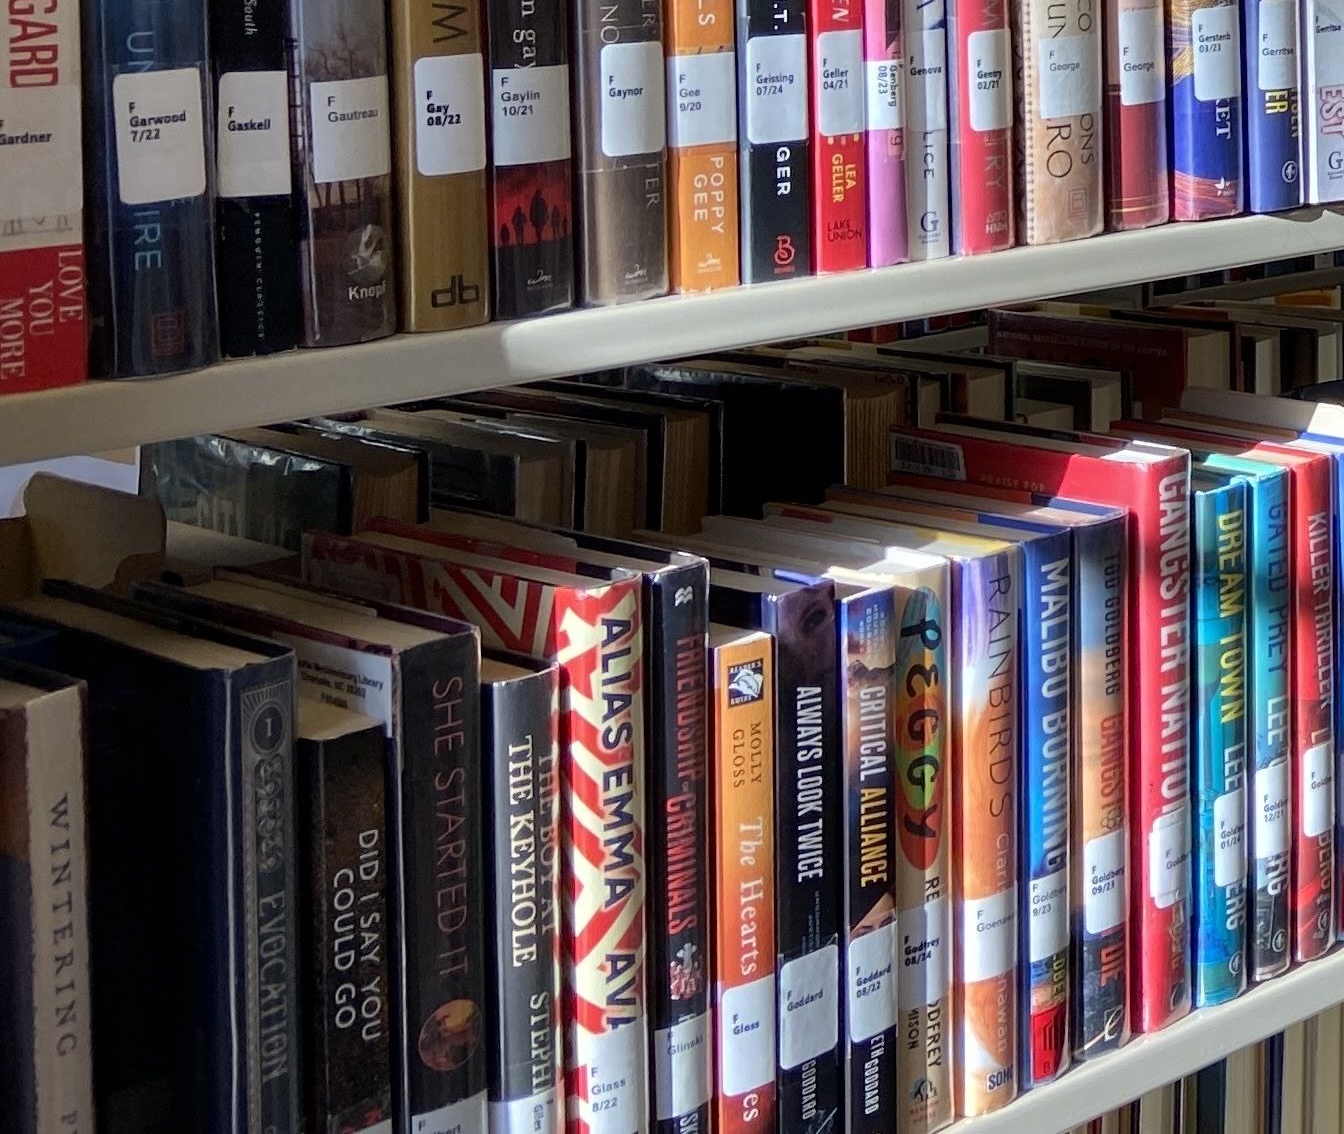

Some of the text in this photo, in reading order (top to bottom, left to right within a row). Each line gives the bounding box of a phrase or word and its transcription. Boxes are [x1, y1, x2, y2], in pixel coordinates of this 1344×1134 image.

[501, 89, 541, 103] Gaylin
[608, 86, 644, 98] Gaynor
[756, 72, 795, 85] Geissing
[756, 85, 783, 96] 07/24
[909, 65, 943, 77] Genova
[129, 111, 187, 127] Garwood
[228, 118, 271, 132] Gaskell
[426, 103, 450, 117] Gay
[501, 106, 534, 118] 10/21
[693, 174, 708, 222] GEE
[709, 156, 725, 235] POPPY
[831, 153, 845, 204] GELLER
[844, 163, 857, 190] LEA
[827, 229, 863, 243] UNION
[28, 281, 55, 337] YOU
[58, 250, 84, 323] LOVE
[348, 283, 387, 301] Knopf
[2, 298, 26, 378] MORE
[1158, 472, 1190, 674] GANGSTER
[1308, 511, 1331, 597] KILLER
[1104, 596, 1121, 697] GOLDBERG
[1217, 511, 1245, 723] DREAM TOWN
[859, 684, 887, 781] CRITICAL
[989, 574, 1014, 818] RAINBIRDS
[1040, 558, 1070, 871] MALIBU BURNING
[602, 618, 636, 909] ALIAS EMMA
[732, 728, 746, 788] GLOSS
[749, 720, 762, 784] MOLLY
[796, 686, 824, 883] ALWAYS LOOK TWICE
[432, 676, 468, 933] SHE STARTED
[859, 786, 888, 888] ALLIANCE
[508, 734, 538, 967] THE KEYHOLE
[666, 792, 697, 936] CRIMINALS
[50, 792, 78, 1058] WINTERING
[739, 816, 765, 977] The Hearts
[333, 868, 356, 1029] COULD GO
[358, 830, 382, 1042] DID SAY YOU
[259, 890, 288, 1082] EVOCATION
[787, 989, 824, 1012] Goddard
[856, 962, 892, 987] Goddard
[590, 1078, 627, 1096] Glass
